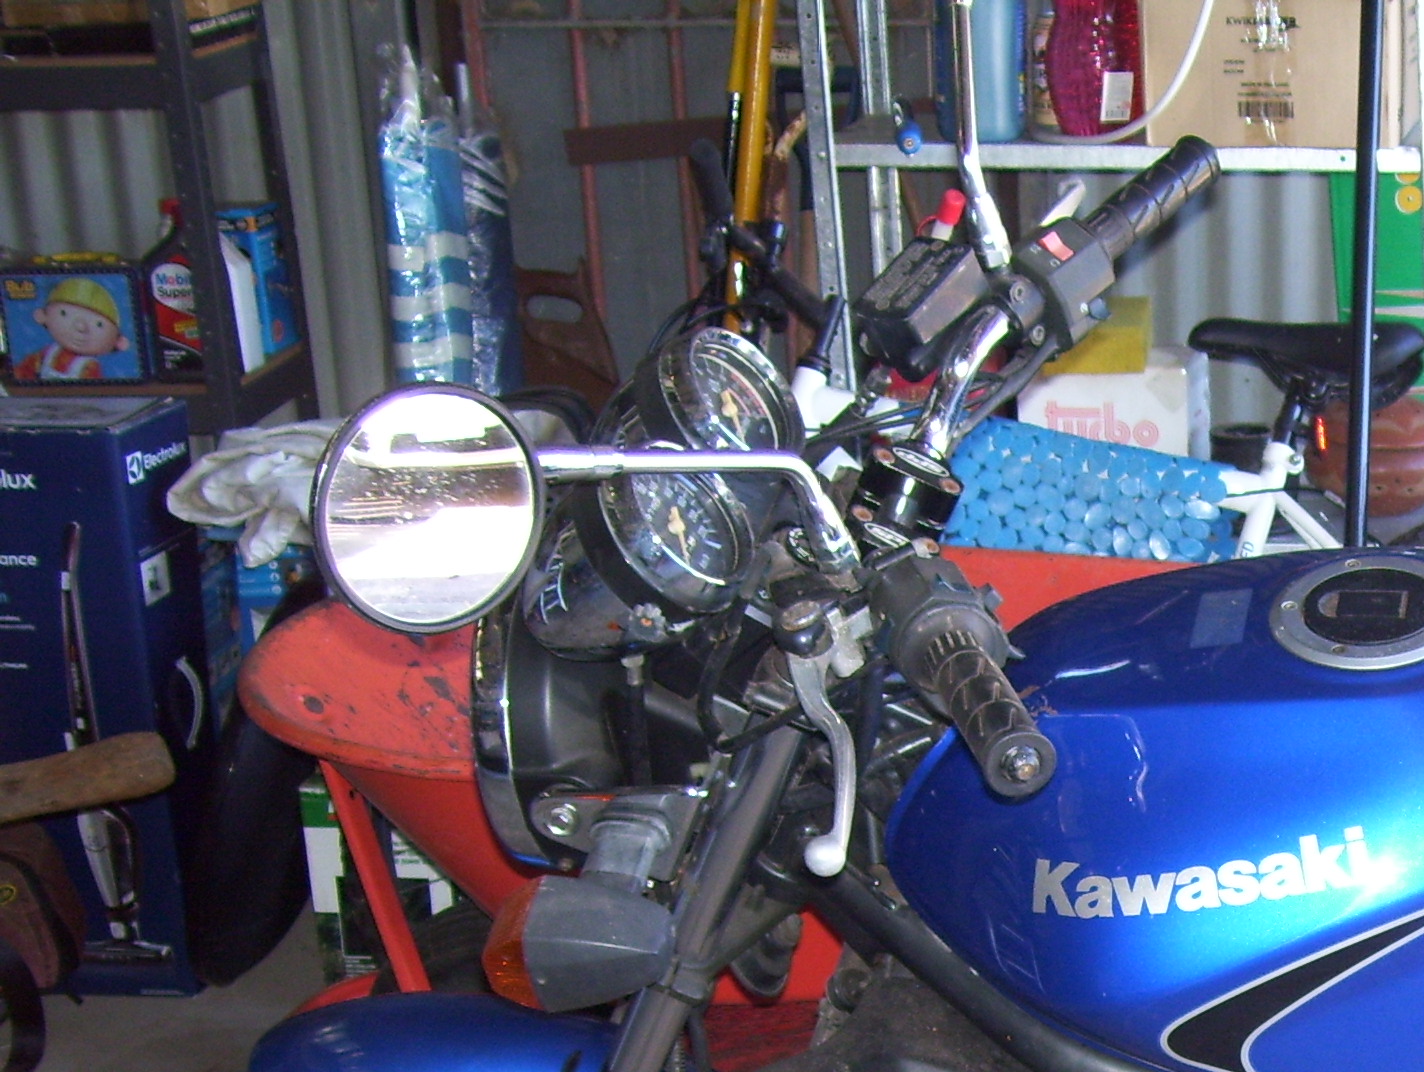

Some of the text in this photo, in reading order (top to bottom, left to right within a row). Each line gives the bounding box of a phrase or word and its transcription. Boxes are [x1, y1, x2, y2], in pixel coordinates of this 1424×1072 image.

[156, 273, 189, 286] Mobi
[143, 442, 186, 469] Electrolux
[0, 469, 37, 490] lux
[1032, 825, 1370, 921] Kawasaki
